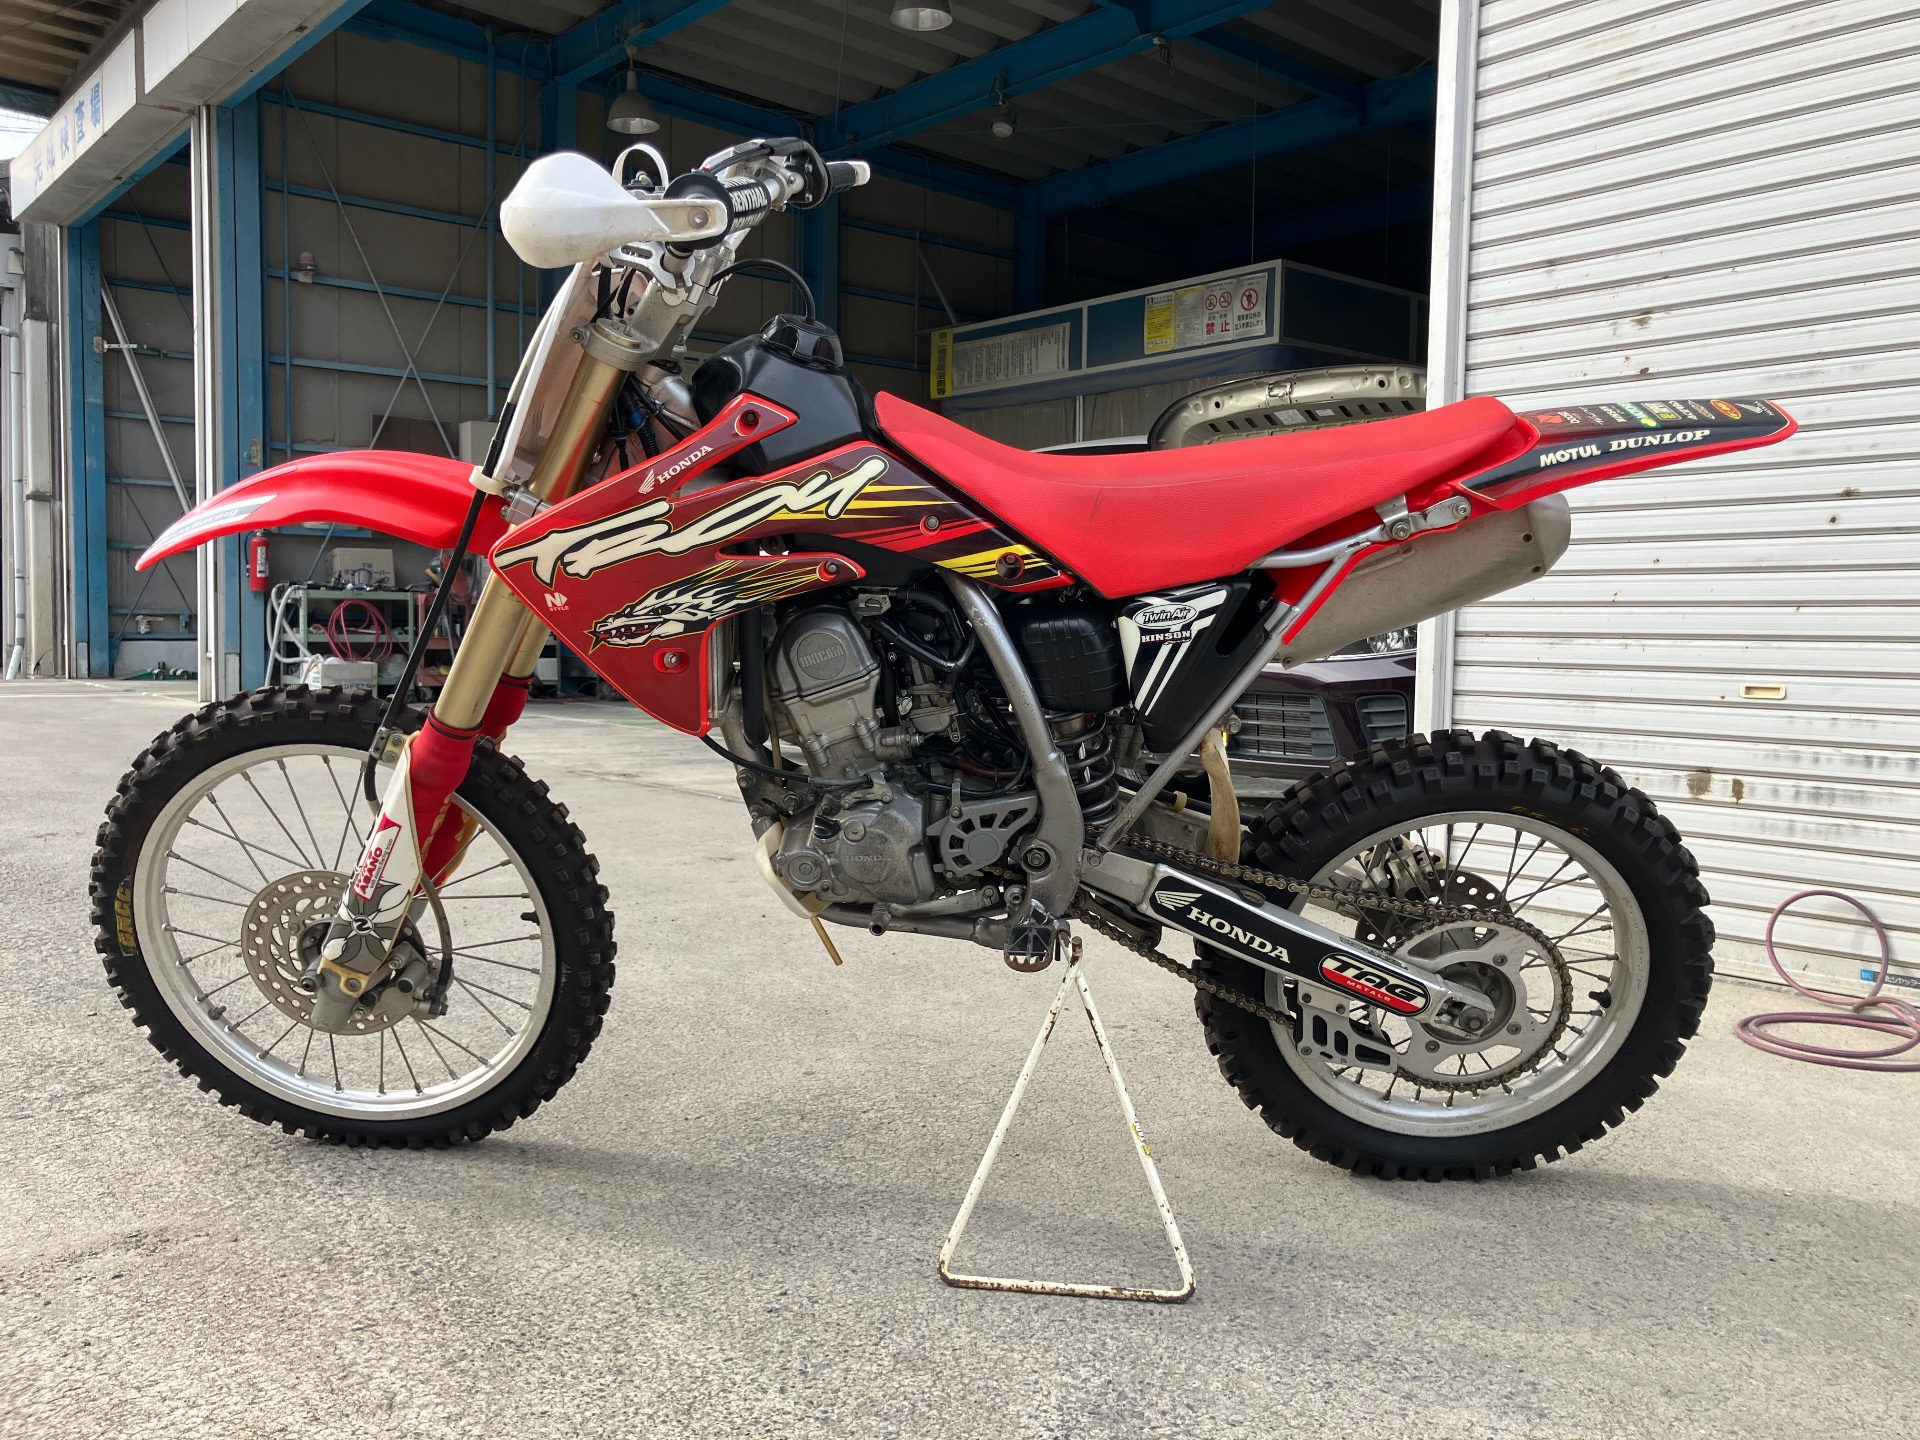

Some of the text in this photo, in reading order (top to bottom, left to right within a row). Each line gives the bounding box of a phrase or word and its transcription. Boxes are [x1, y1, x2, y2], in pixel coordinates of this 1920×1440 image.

[656, 445, 714, 485] HONDA
[1540, 429, 1711, 468] MOTUL DUNLOP
[1143, 609, 1171, 624] Twin
[1171, 606, 1191, 620] Air
[1141, 630, 1191, 643] HINSON
[799, 644, 845, 669] UNICAM
[1186, 906, 1291, 964] HONDA
[1327, 955, 1428, 1003] TAG
